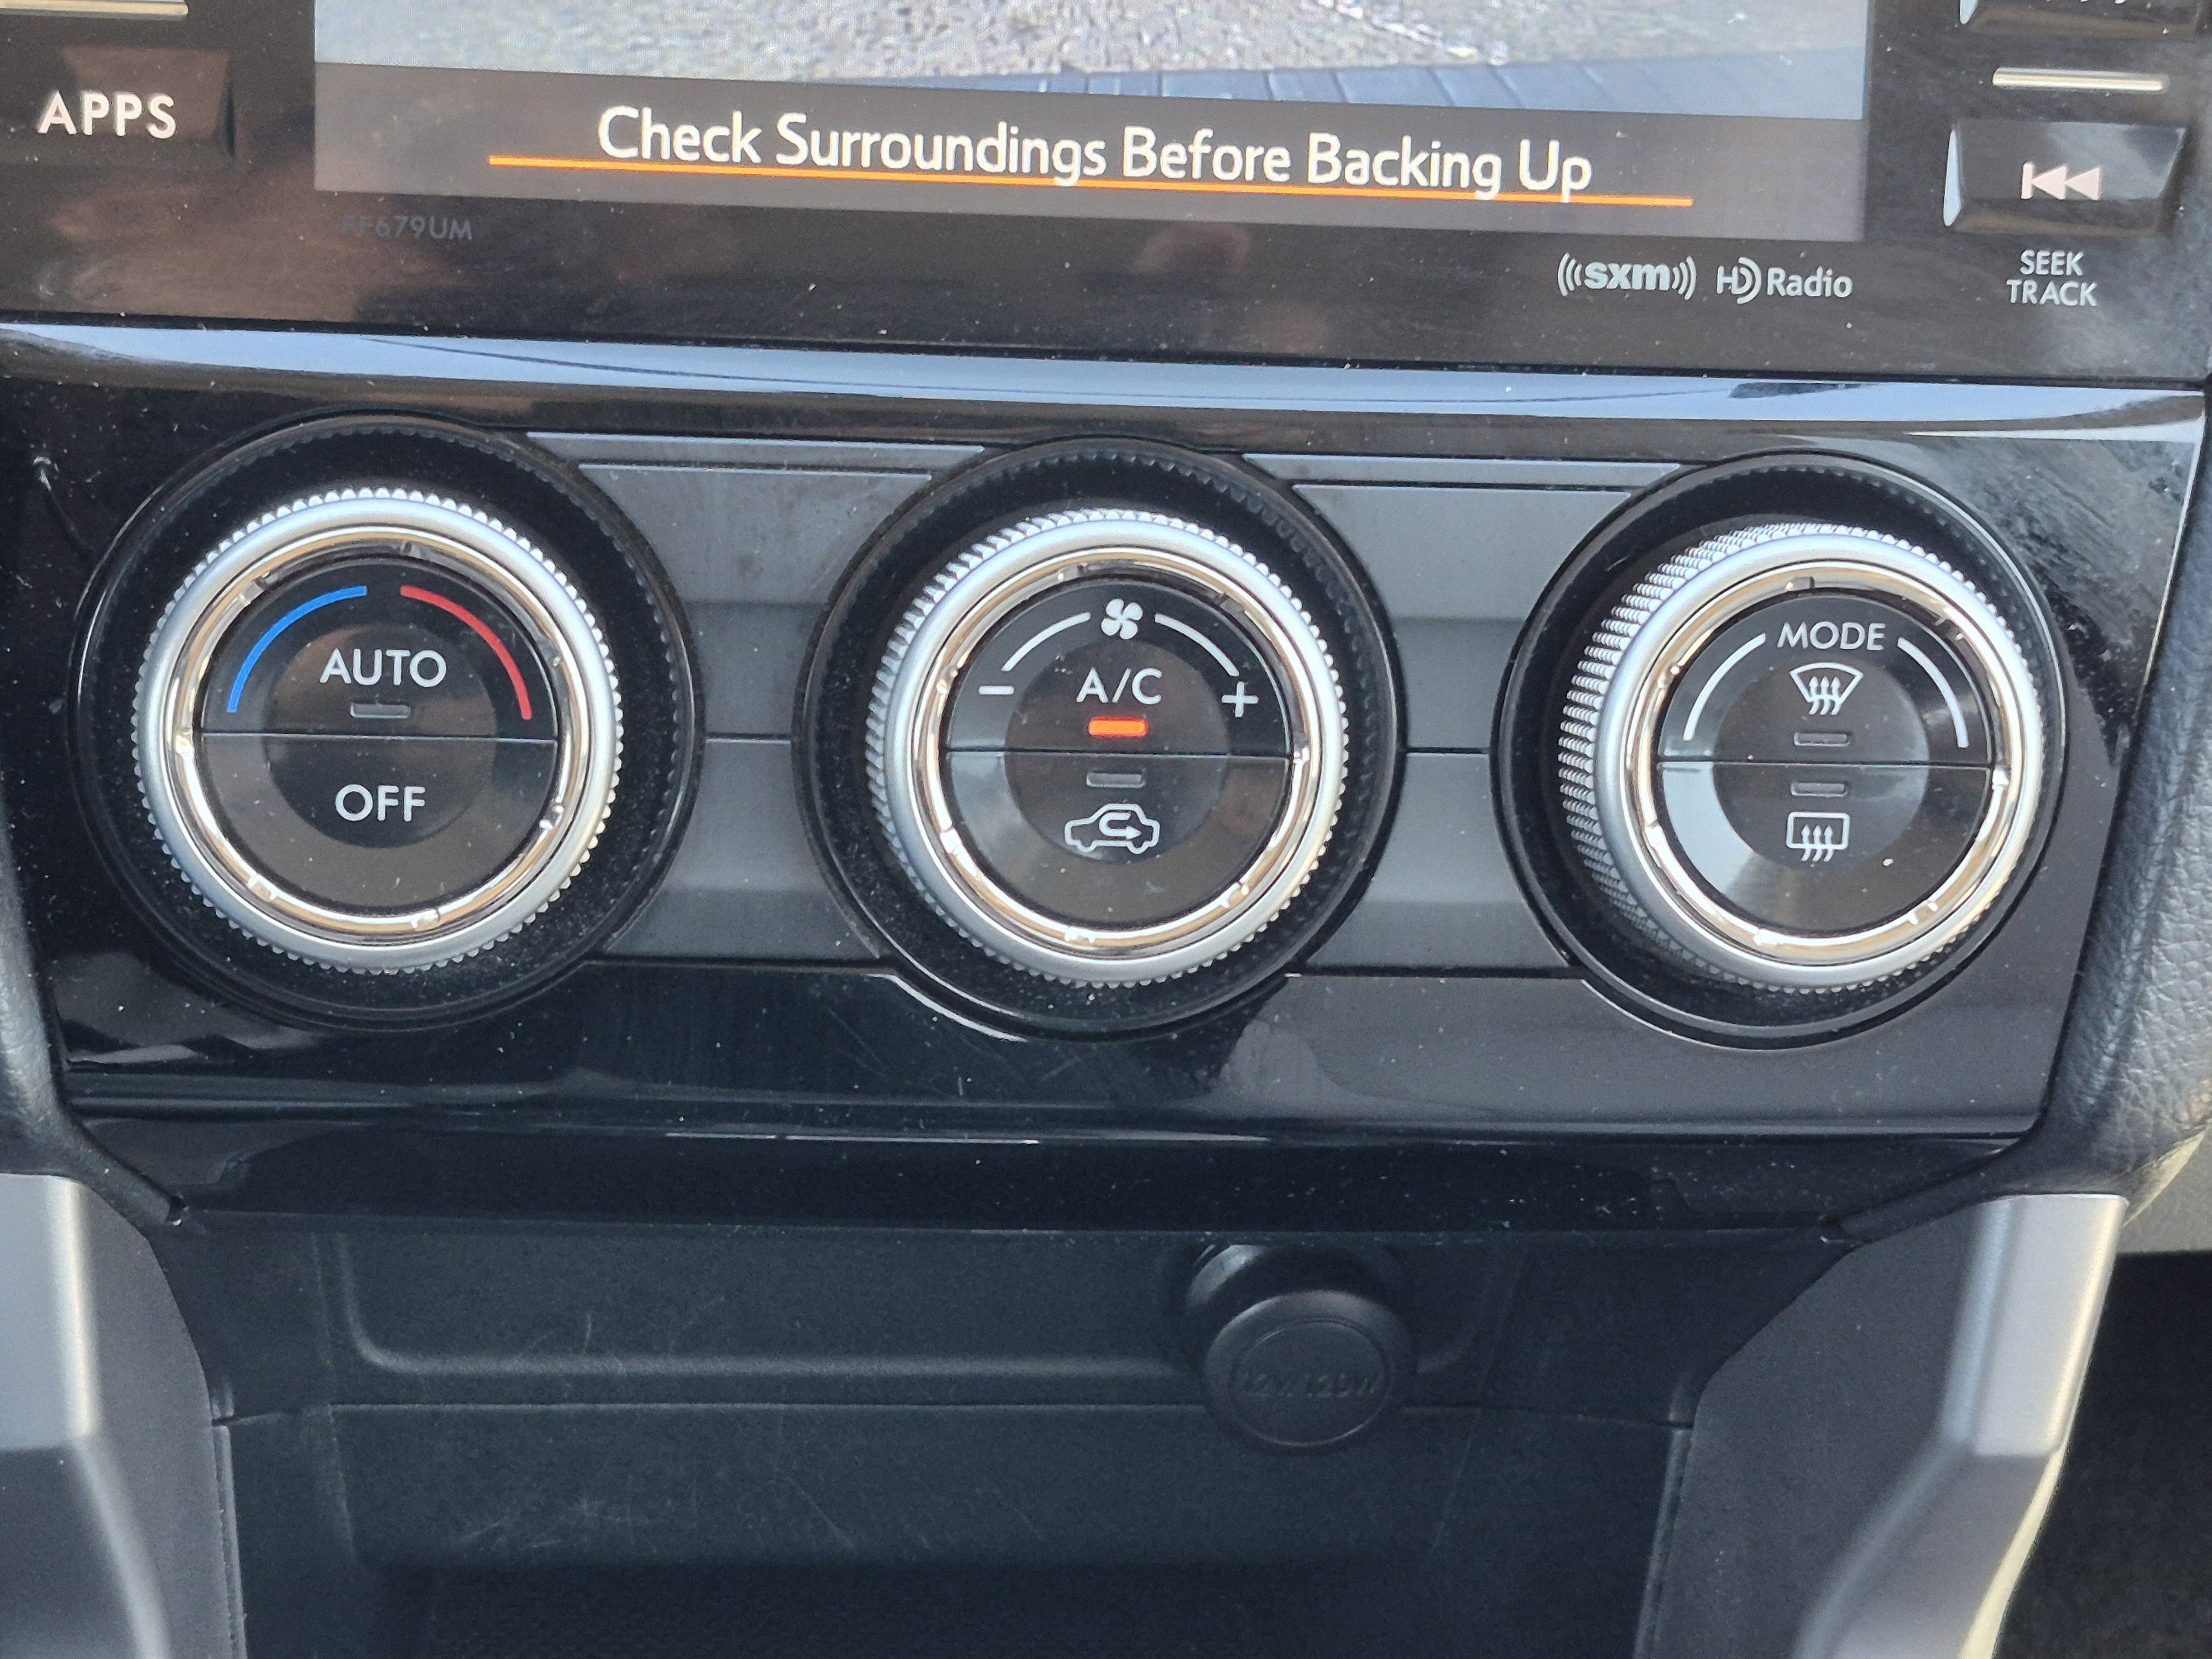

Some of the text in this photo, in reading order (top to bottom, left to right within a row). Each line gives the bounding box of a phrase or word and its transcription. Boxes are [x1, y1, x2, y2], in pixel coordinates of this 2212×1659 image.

[37, 90, 176, 140] APPS
[597, 105, 1592, 203] Check Surroundings Before Backing Up
[1767, 265, 1853, 298] Radio
[2020, 249, 2084, 276] SEEK
[2006, 279, 2098, 307] TRACK
[1776, 620, 1886, 651] MODE
[319, 648, 447, 688] AUTO
[1076, 667, 1162, 705] A/C
[335, 784, 426, 822] OFF
